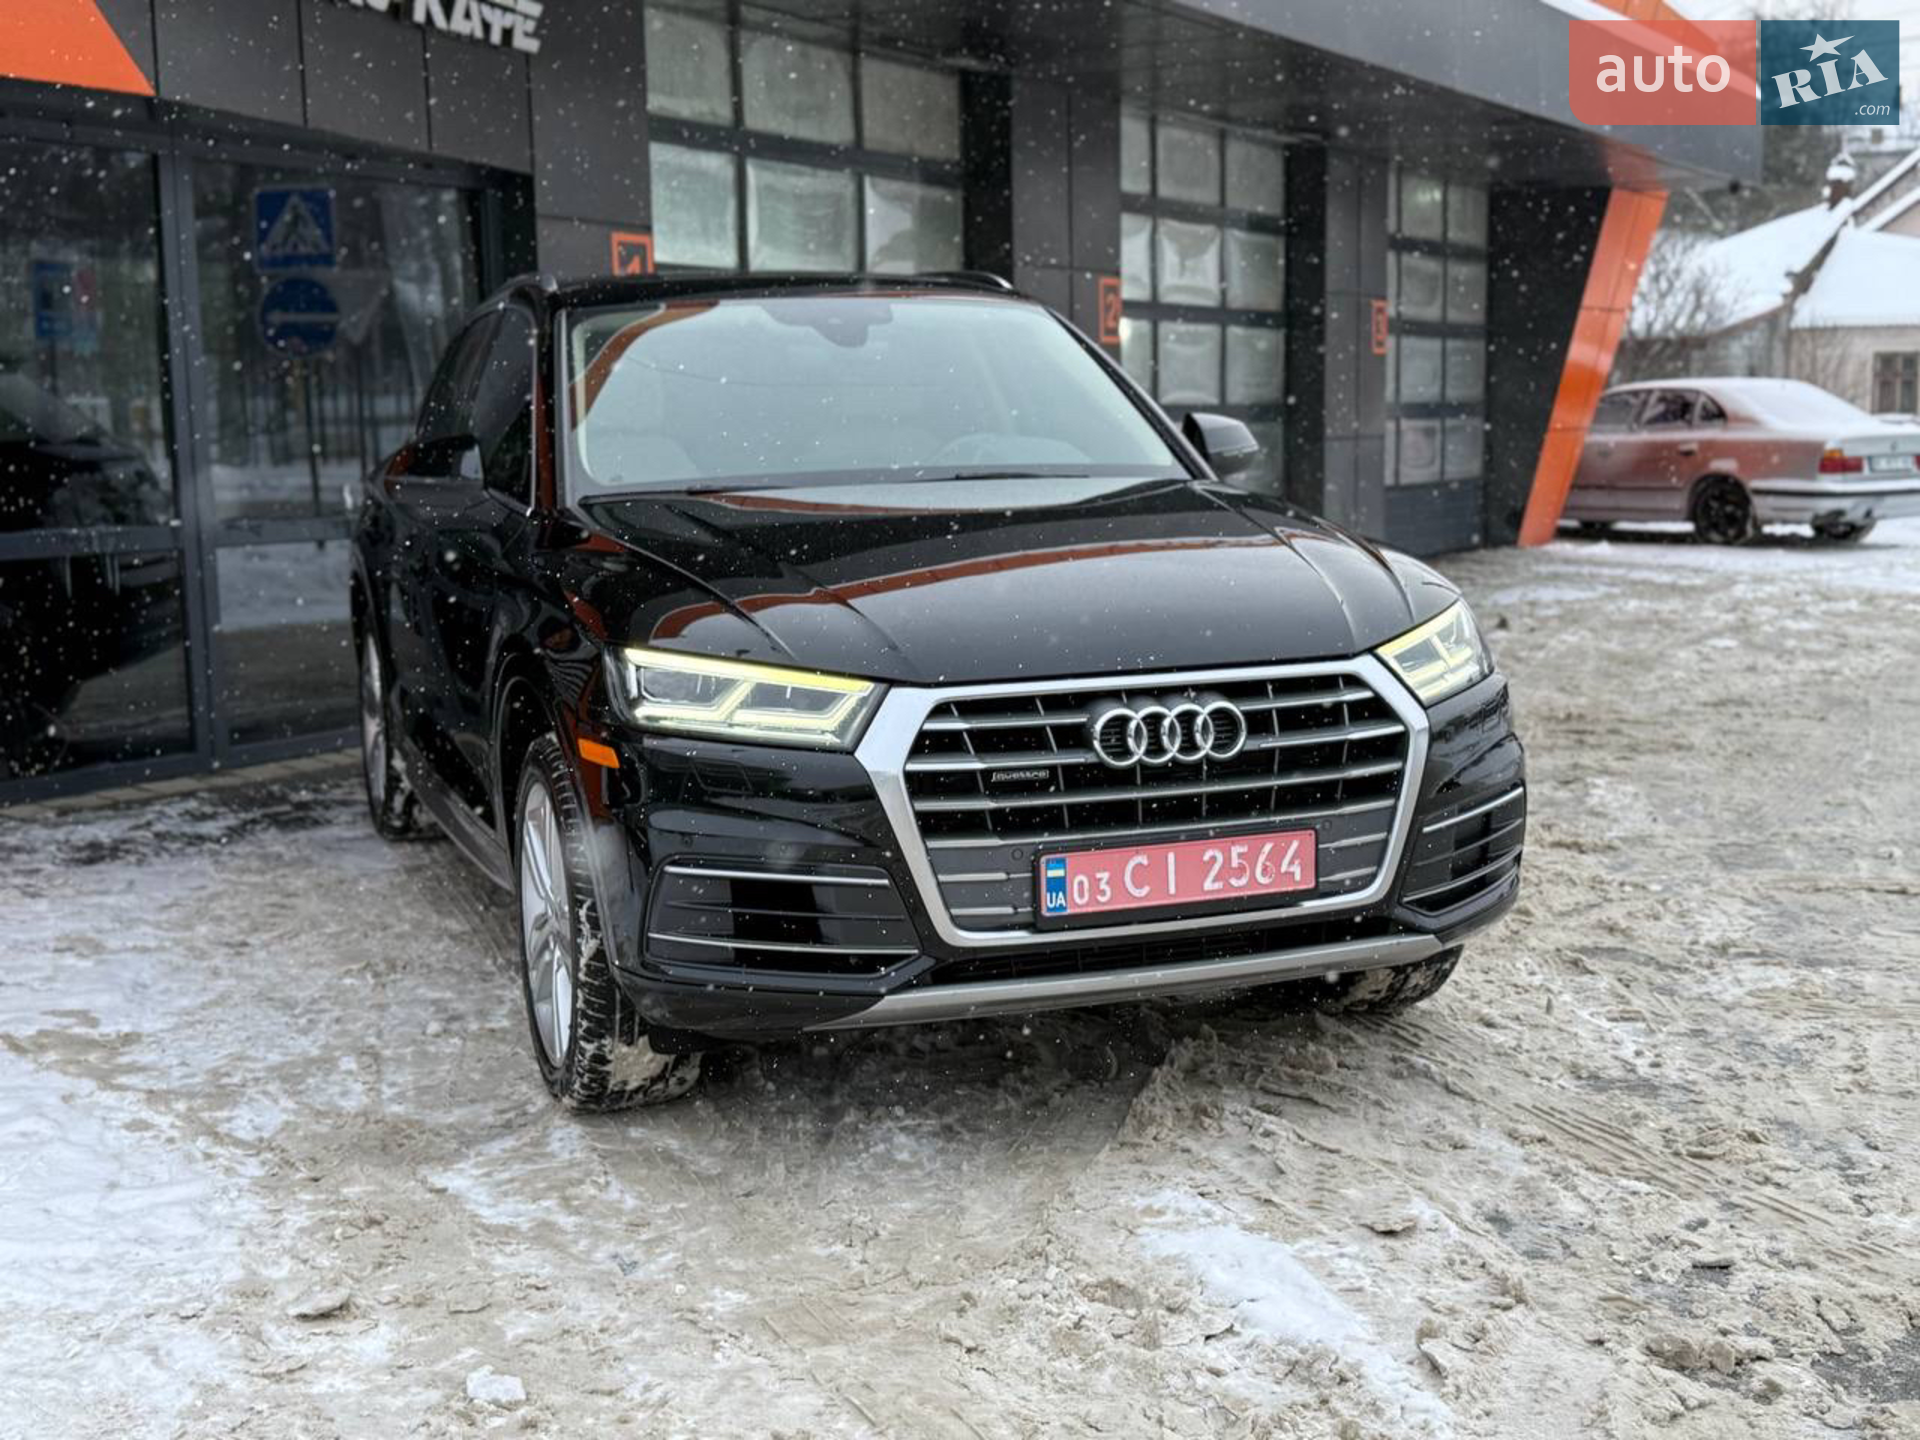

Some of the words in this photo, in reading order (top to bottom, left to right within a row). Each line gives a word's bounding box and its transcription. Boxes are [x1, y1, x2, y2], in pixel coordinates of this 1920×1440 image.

[1103, 292, 1117, 328] 2
[1073, 871, 1111, 905] 03
[1202, 840, 1302, 891] 2564
[1046, 891, 1066, 908] UA
